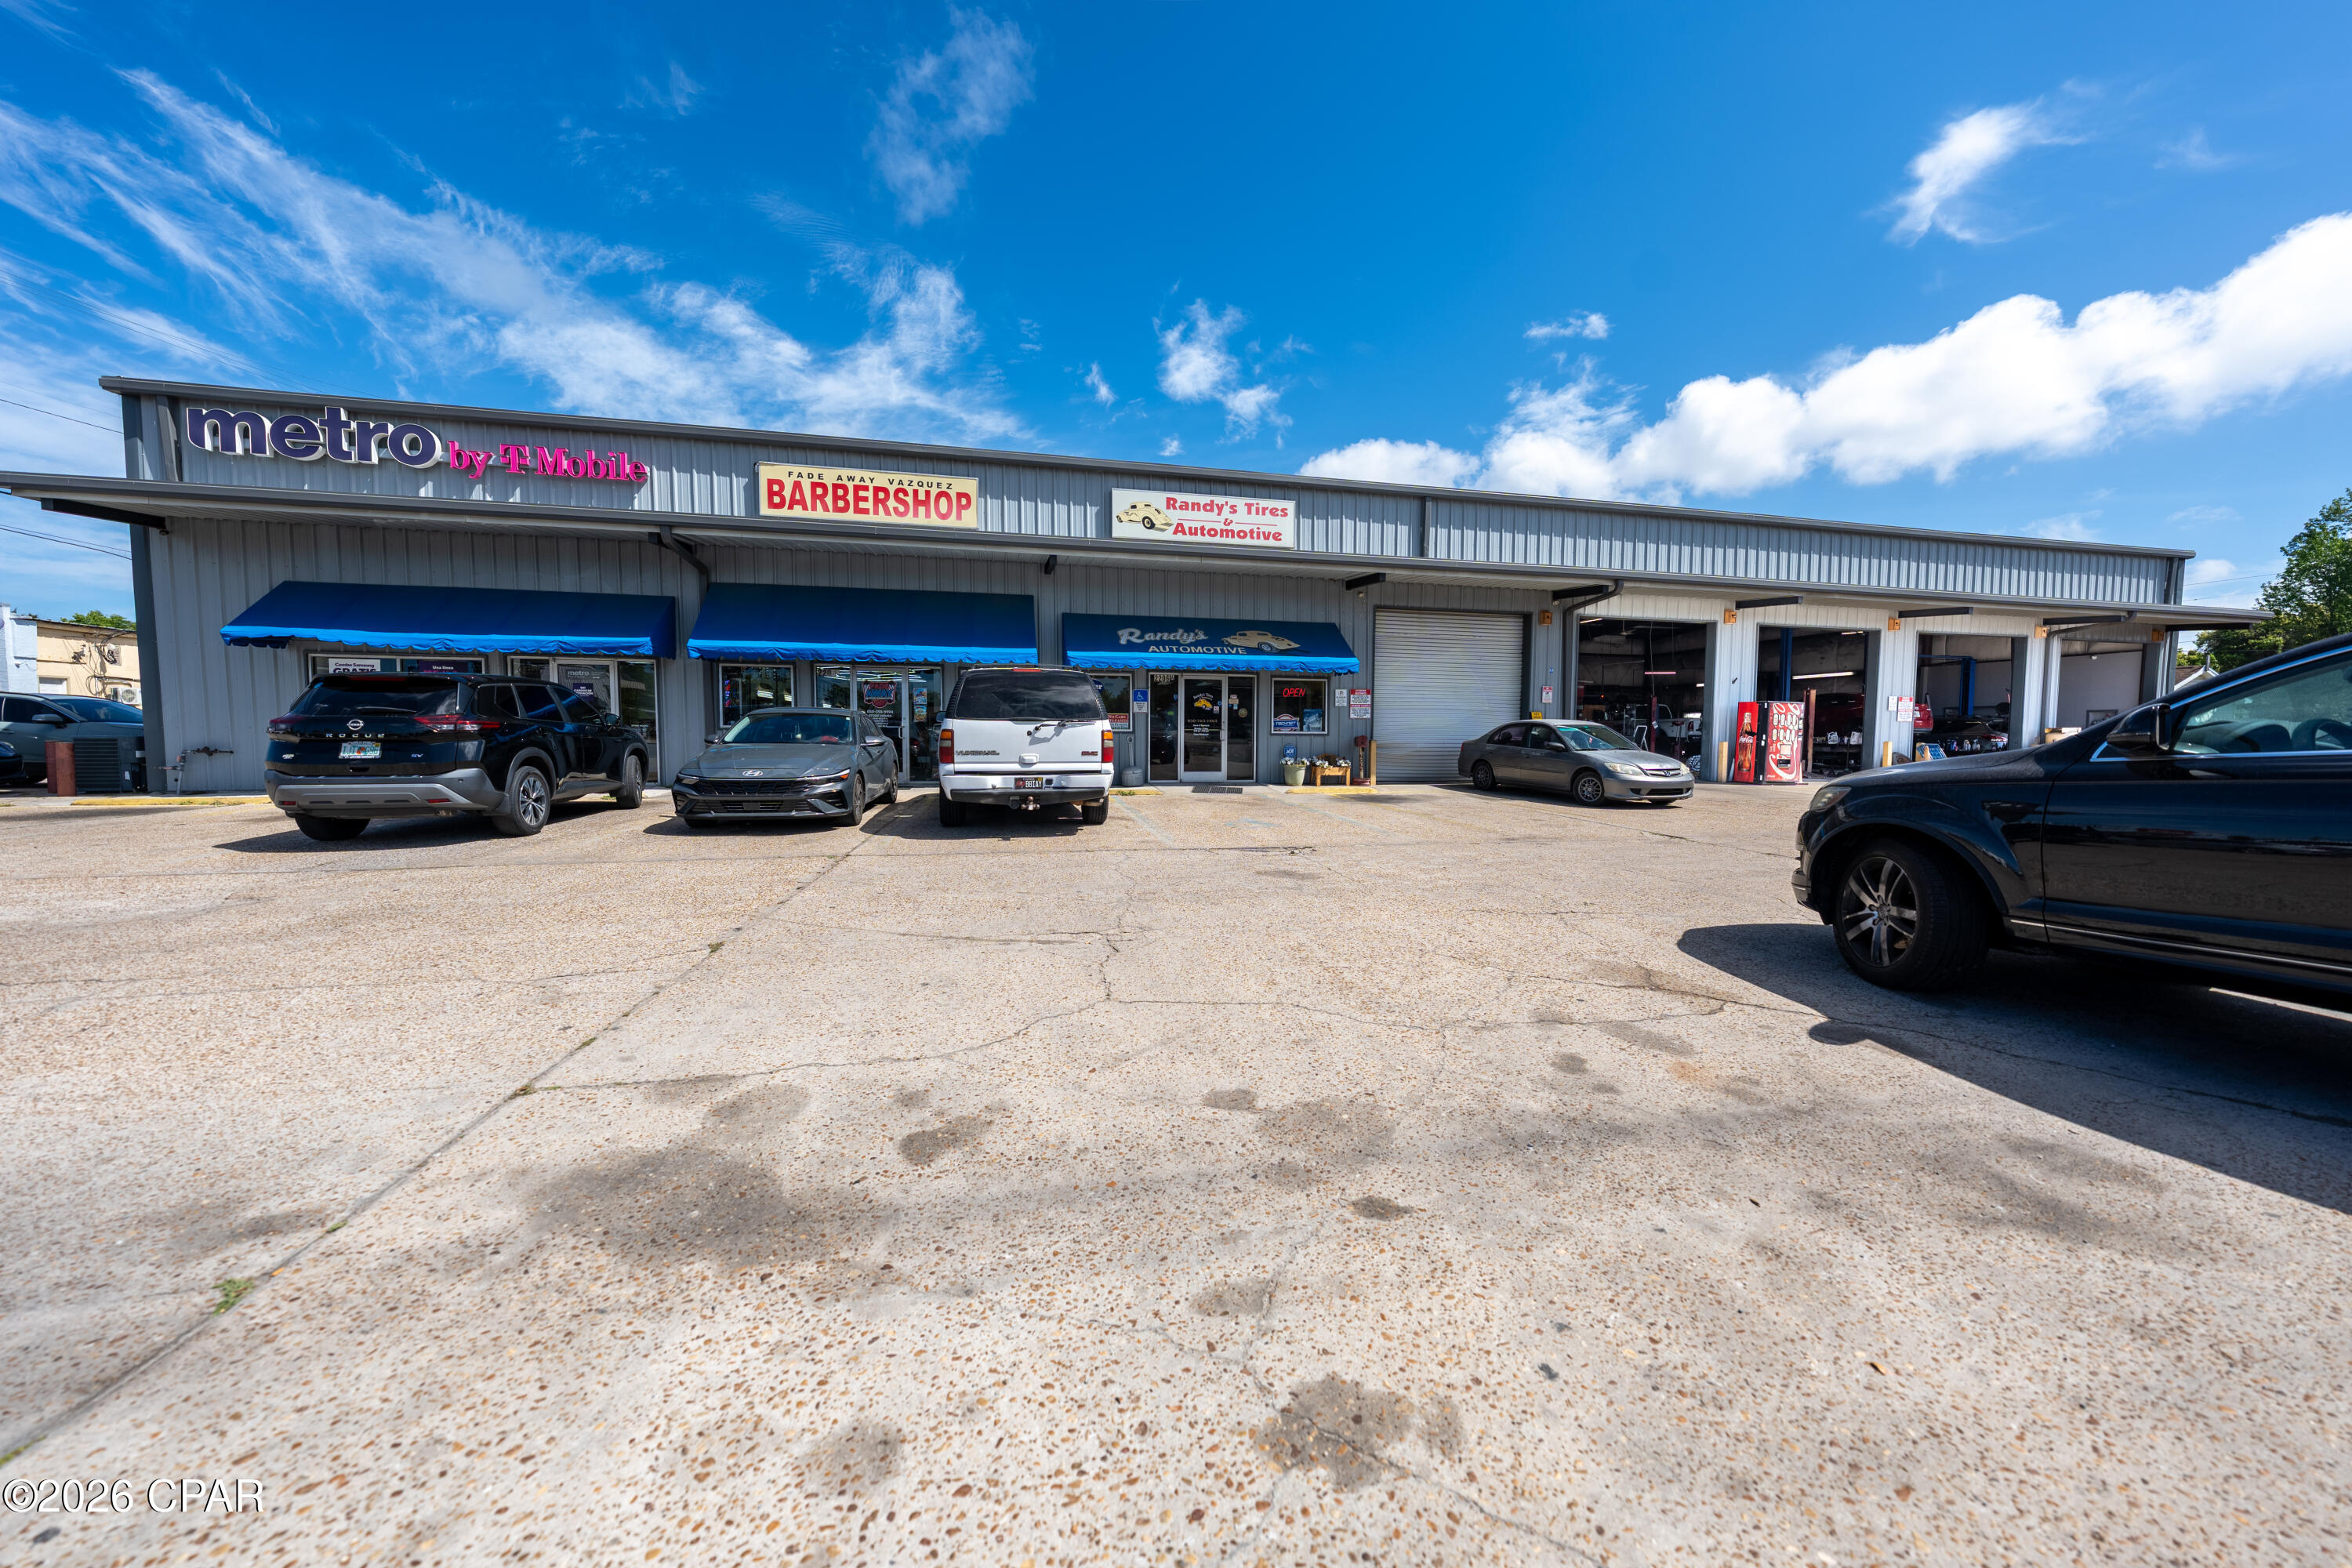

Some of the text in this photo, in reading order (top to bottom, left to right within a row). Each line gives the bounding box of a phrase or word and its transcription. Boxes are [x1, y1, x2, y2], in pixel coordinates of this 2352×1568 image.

[186, 406, 441, 468] metro
[447, 440, 495, 479] by
[788, 471, 953, 490] FADE AWAY VAZQUEZ
[767, 478, 972, 521] BARBERSHOP
[1166, 497, 1289, 517] Randy's Tires
[1173, 523, 1283, 542] Automotive
[1117, 627, 1209, 644] Randy's
[1148, 645, 1247, 655] AUTOMOTIVE
[1283, 688, 1305, 697] OPEN
